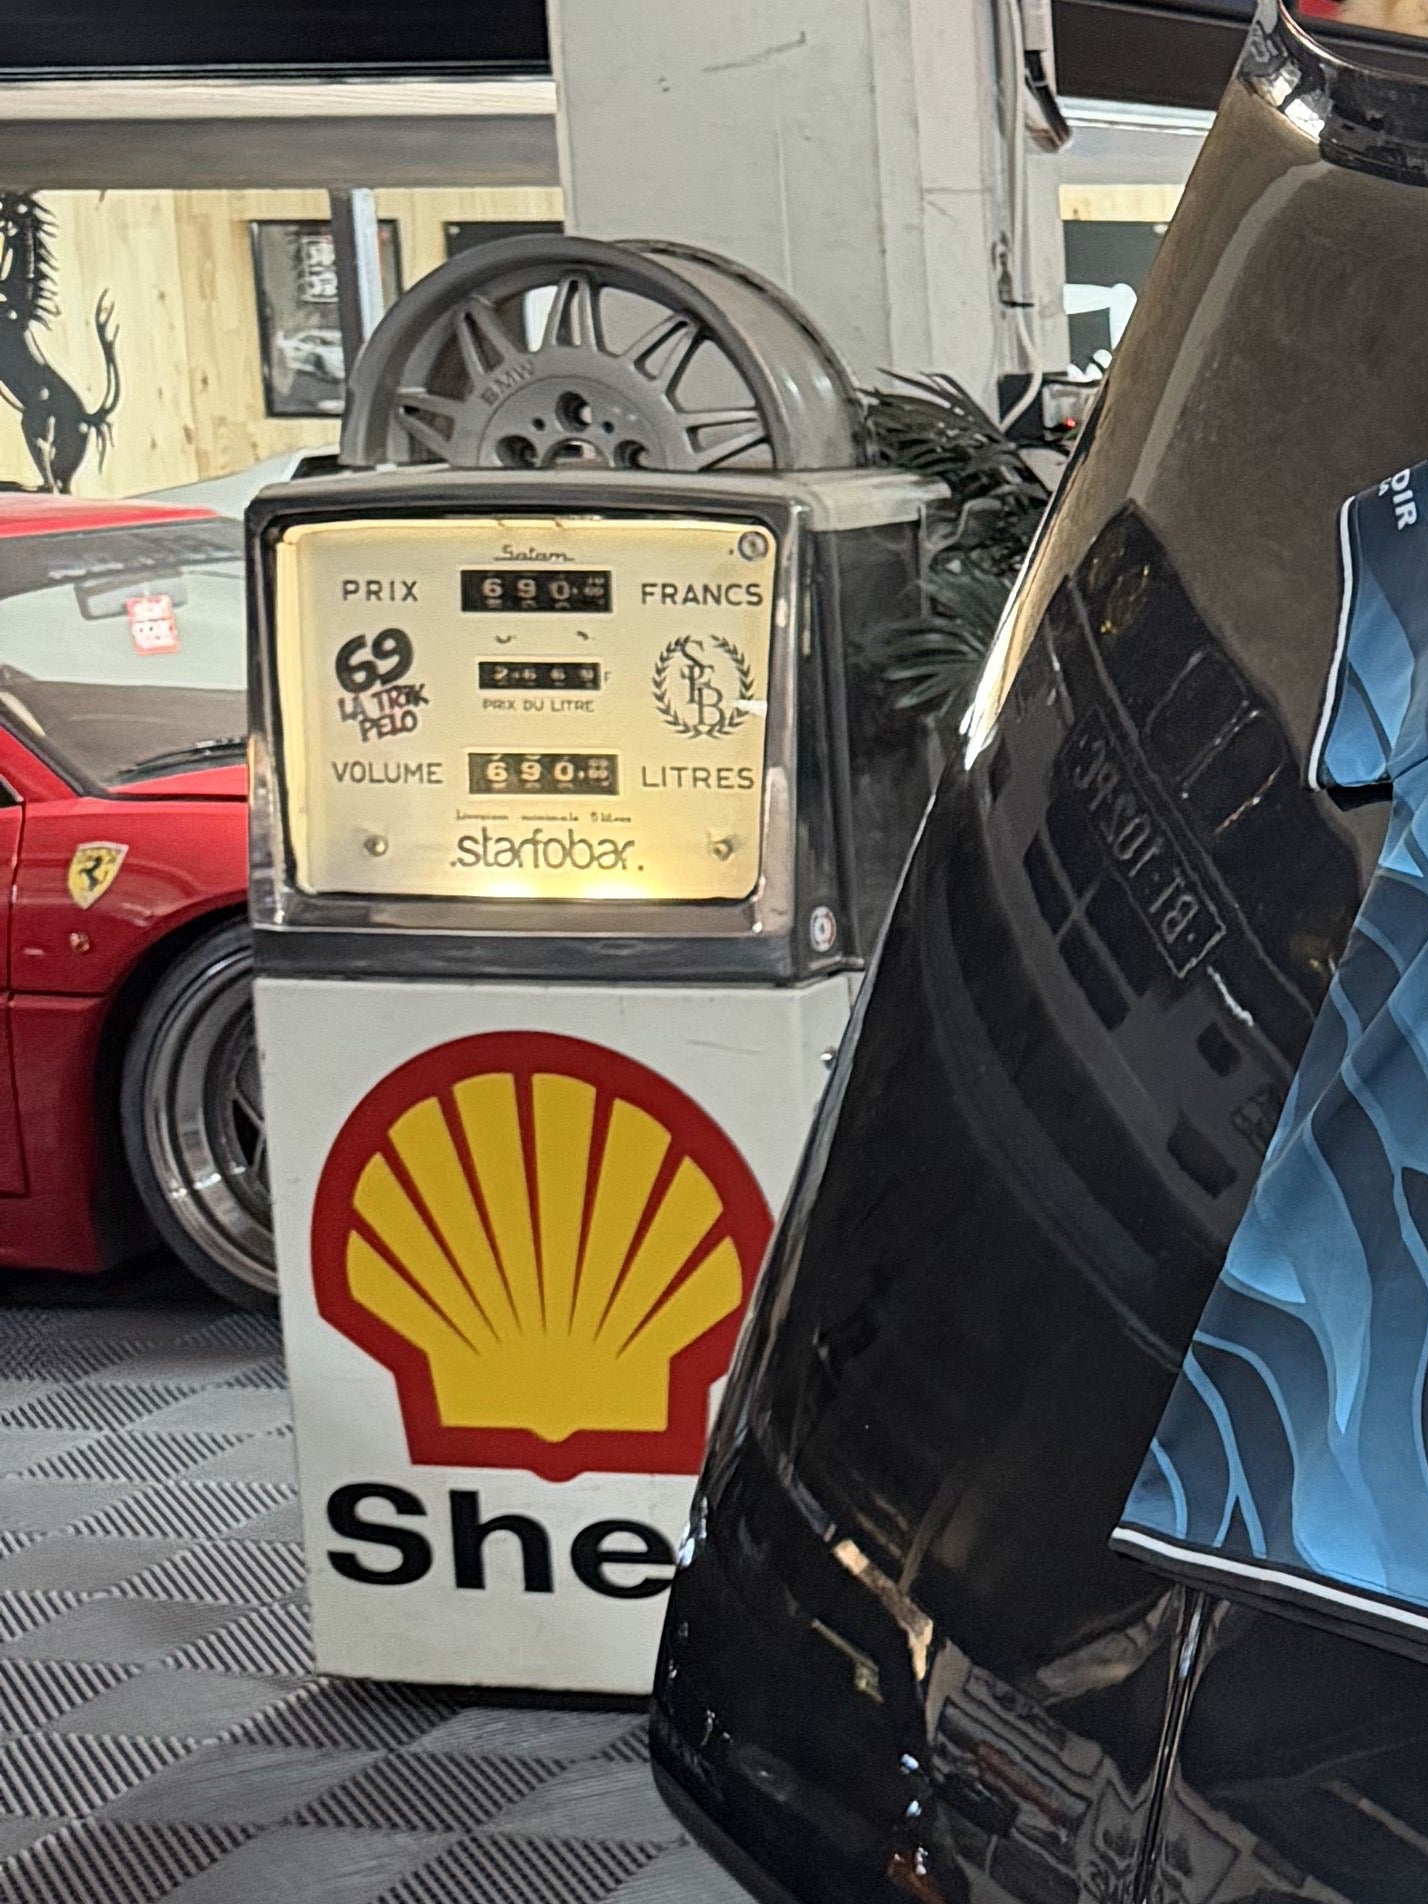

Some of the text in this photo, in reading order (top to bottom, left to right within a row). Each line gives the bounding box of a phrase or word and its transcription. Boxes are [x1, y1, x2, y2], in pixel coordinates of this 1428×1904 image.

[342, 580, 418, 602] PRIX
[641, 583, 764, 606] FRANCS
[335, 628, 414, 695] 69
[338, 696, 367, 723] LA
[482, 698, 595, 713] PRIX DU LITRE
[359, 709, 418, 743] PELO
[331, 761, 443, 784] VOLUME
[641, 766, 754, 789] LITRES
[326, 1482, 677, 1599] She
